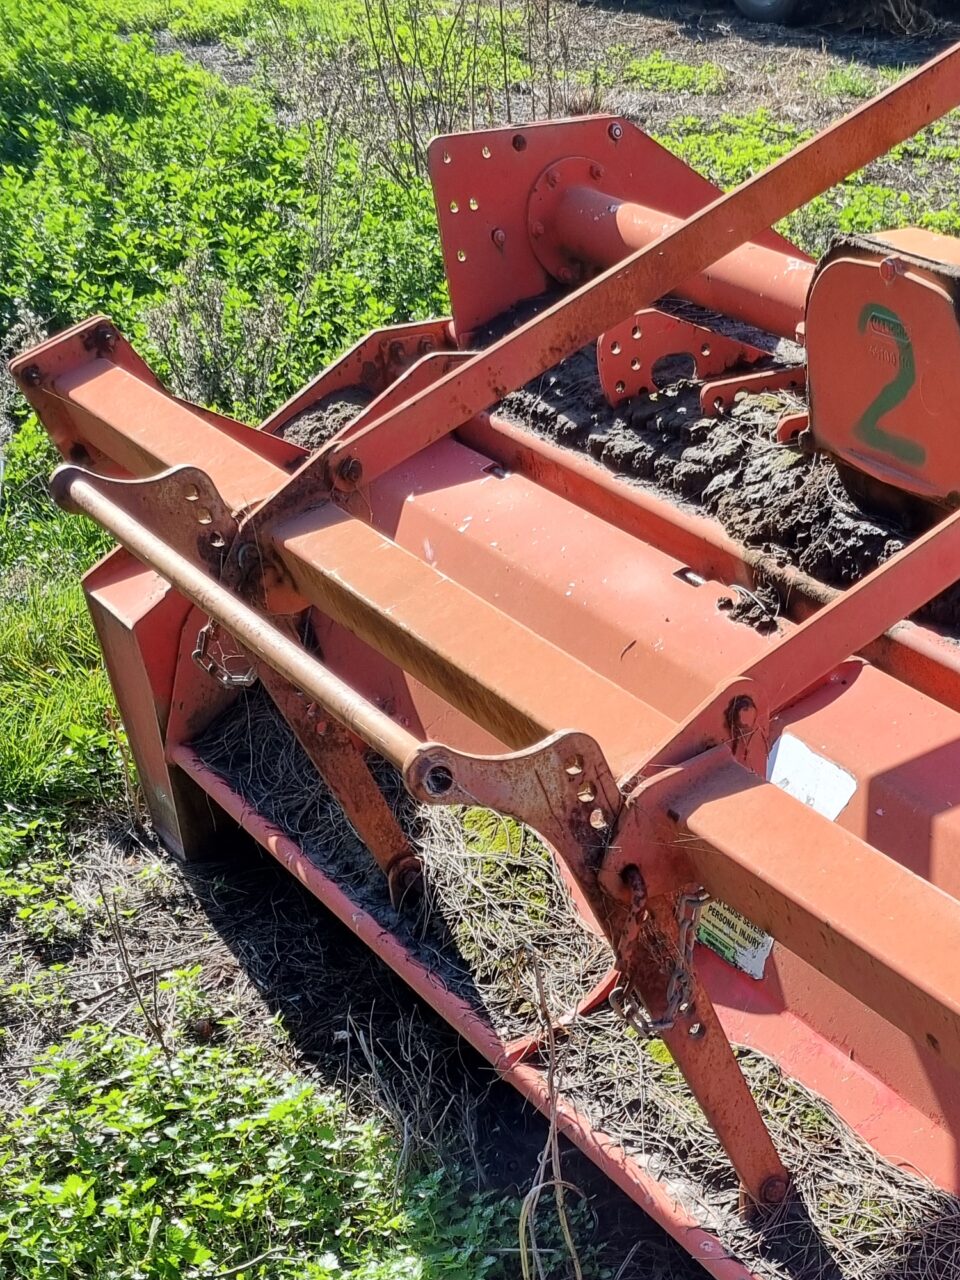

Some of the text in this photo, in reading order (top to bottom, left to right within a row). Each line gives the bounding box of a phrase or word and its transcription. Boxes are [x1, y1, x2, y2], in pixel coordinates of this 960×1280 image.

[853, 302, 927, 468] 2
[707, 905, 739, 934] PERSONAL
[739, 928, 762, 950] INJURY
